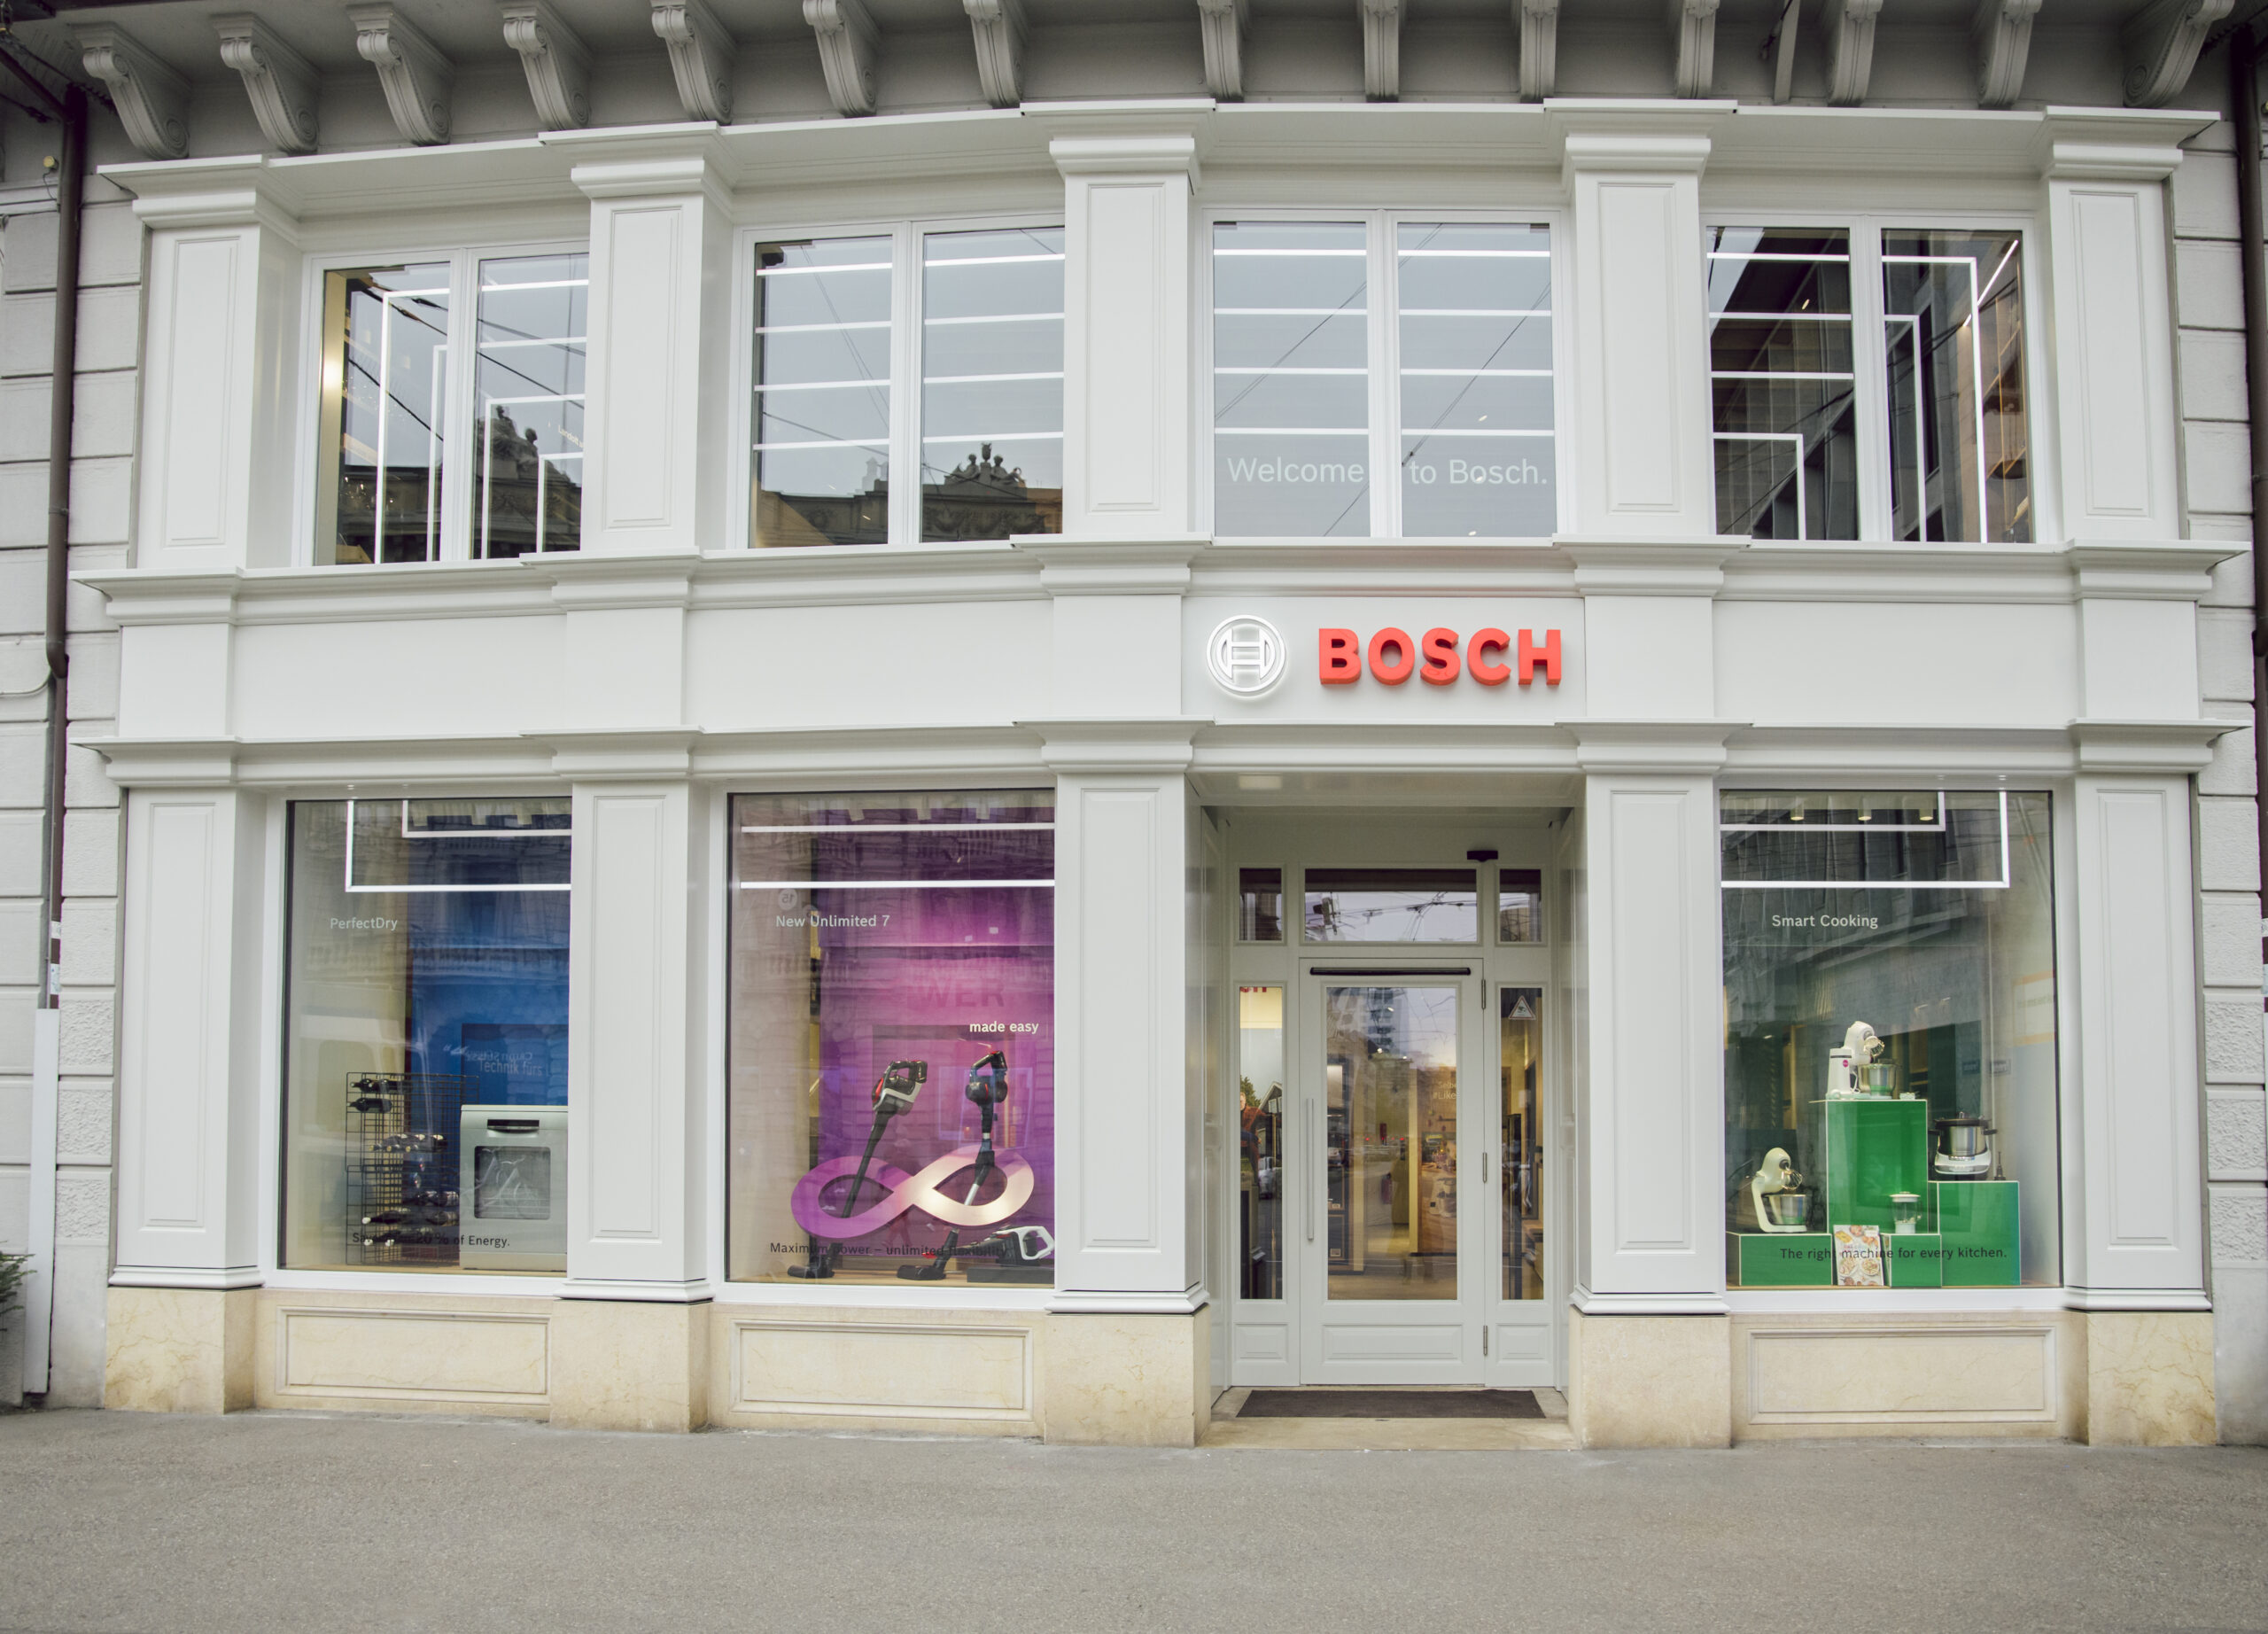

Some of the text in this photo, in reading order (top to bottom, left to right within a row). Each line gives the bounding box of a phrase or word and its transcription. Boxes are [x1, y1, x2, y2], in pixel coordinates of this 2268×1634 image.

[1227, 456, 1548, 485] Welcome to Bosch.
[1319, 627, 1562, 686] BOSCH
[330, 916, 398, 931] PerfectDry
[776, 914, 890, 927] New Unlimited 7
[1772, 914, 1878, 930] Smart Cooking
[969, 1021, 1039, 1034] made easy
[353, 1233, 379, 1244] Sav
[468, 1235, 510, 1248] Energy.
[770, 1242, 828, 1254] Maximm
[1780, 1248, 1804, 1259] The
[1842, 1248, 1894, 1258] machine
[1899, 1248, 1916, 1258] for
[1920, 1249, 1953, 1260] every
[1958, 1247, 2008, 1258] kitchen.
